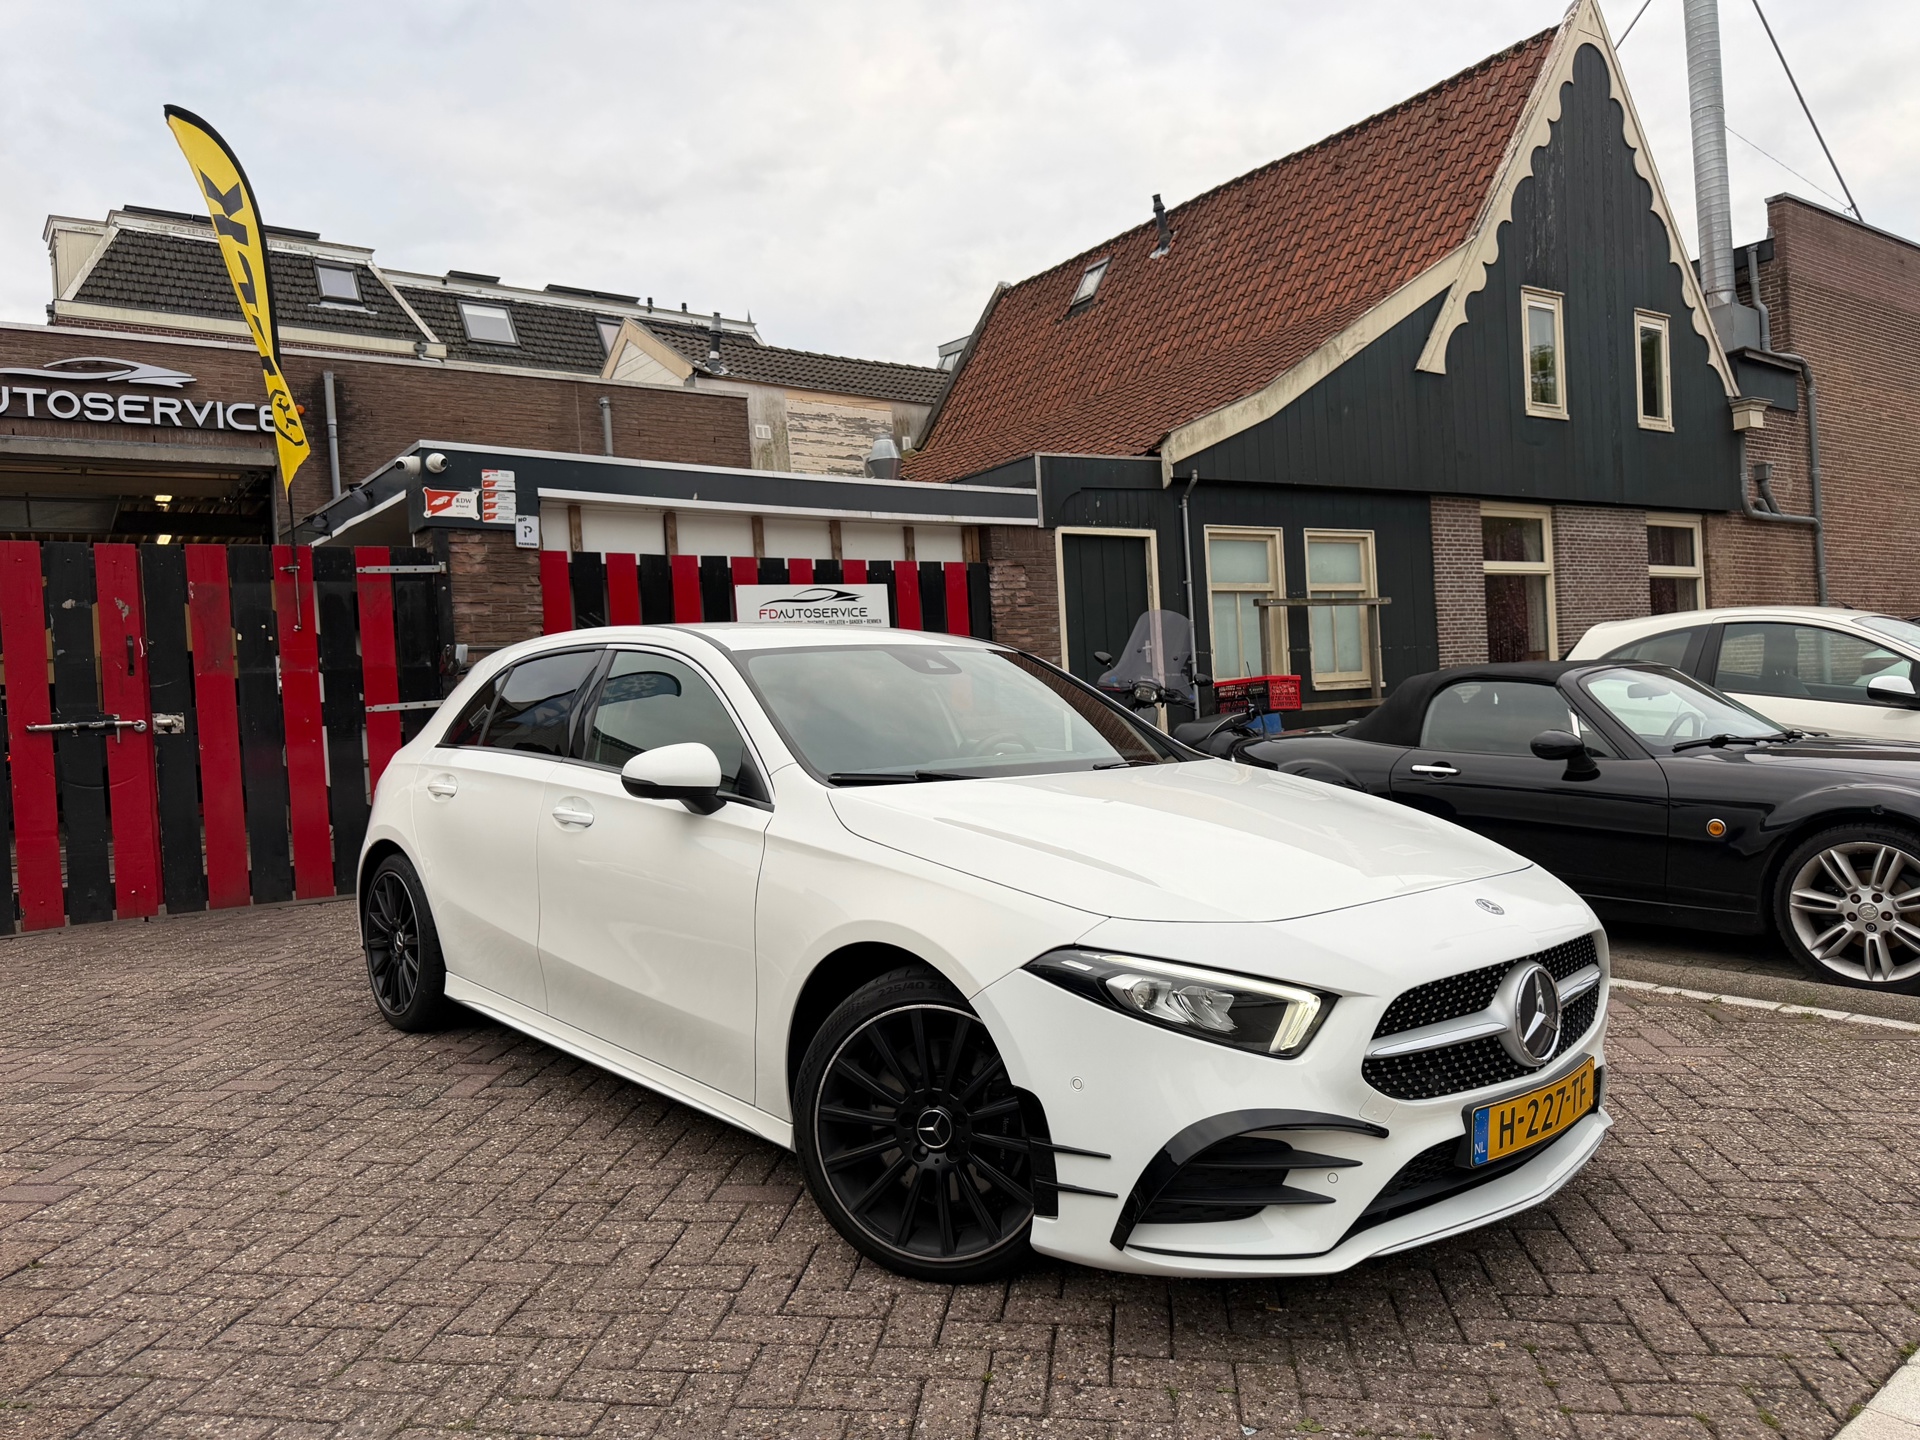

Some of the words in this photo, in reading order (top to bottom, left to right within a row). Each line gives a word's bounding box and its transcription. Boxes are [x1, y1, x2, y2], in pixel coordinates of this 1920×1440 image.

[759, 607, 868, 619] FDAUTOSERVICE
[878, 981, 925, 998] 225/40
[1499, 1071, 1587, 1149] H-227-TF
[1474, 1143, 1486, 1155] NL
